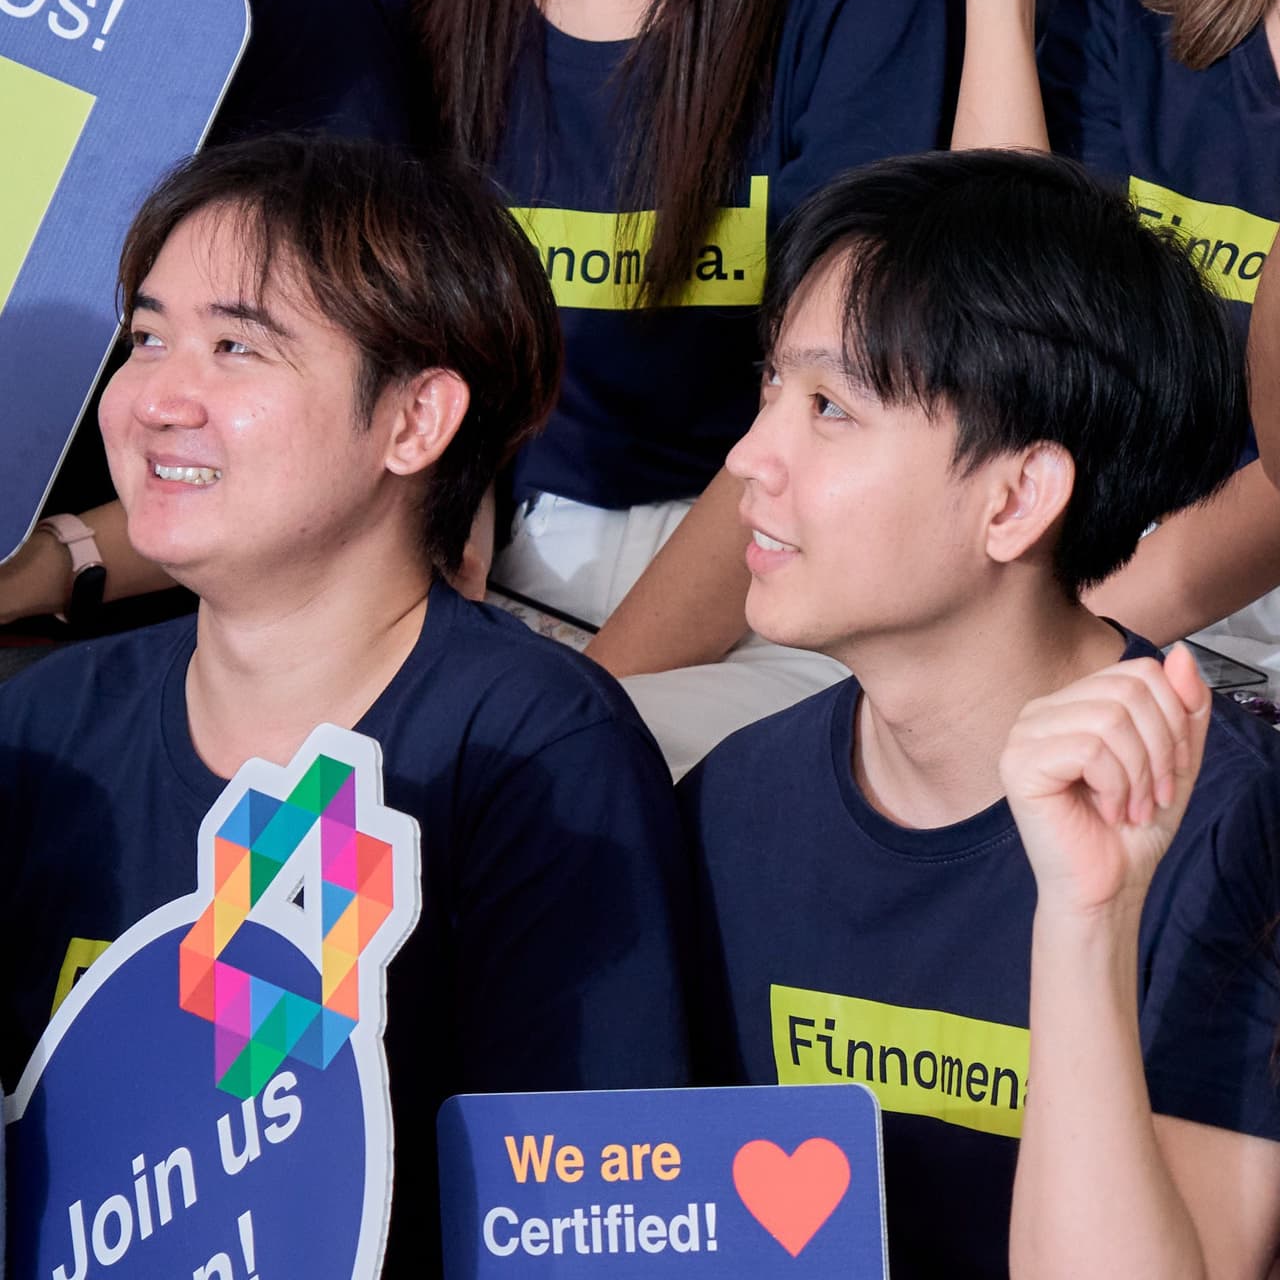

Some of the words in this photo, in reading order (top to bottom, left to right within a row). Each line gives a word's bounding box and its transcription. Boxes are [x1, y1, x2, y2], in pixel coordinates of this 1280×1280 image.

[52, 1146, 198, 1280] Join
[216, 1070, 303, 1176] us
[504, 1134, 585, 1184] We
[600, 1142, 682, 1182] are
[483, 1202, 719, 1247] Certified!
